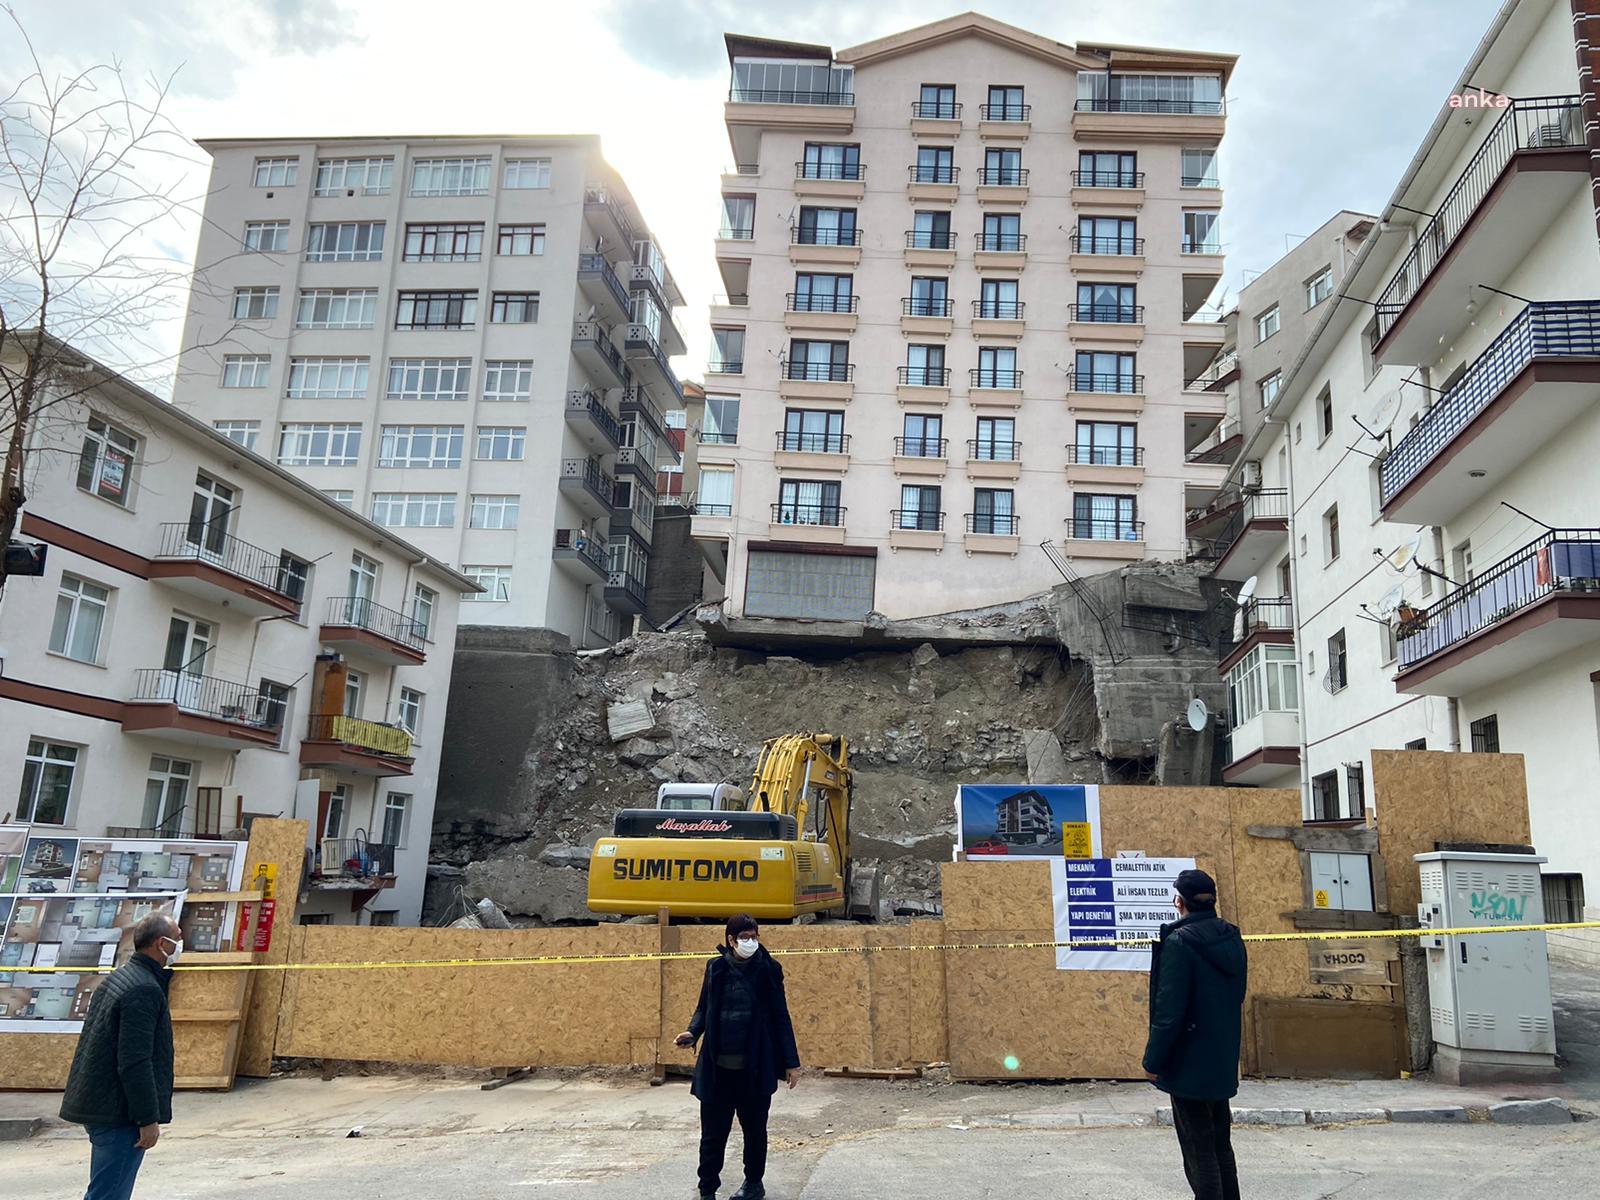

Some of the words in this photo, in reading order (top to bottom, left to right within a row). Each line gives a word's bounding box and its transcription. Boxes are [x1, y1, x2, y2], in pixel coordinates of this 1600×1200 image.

[613, 858, 759, 882] SUMITOMO
[1068, 861, 1096, 872] MEKANİK
[1115, 861, 1151, 872] CEMALETTİN
[1152, 861, 1166, 872] ATİK
[1070, 885, 1097, 896] ELEKTRİK
[1117, 886, 1127, 896] ALİ
[1128, 885, 1146, 896] İHSAN
[1147, 888, 1169, 897] TEZLER
[1071, 911, 1084, 920] YAPI
[1085, 909, 1112, 920] DENETİM
[1133, 912, 1147, 920] YAPI
[1148, 910, 1175, 921] DENETİM
[1120, 931, 1135, 939] 8139
